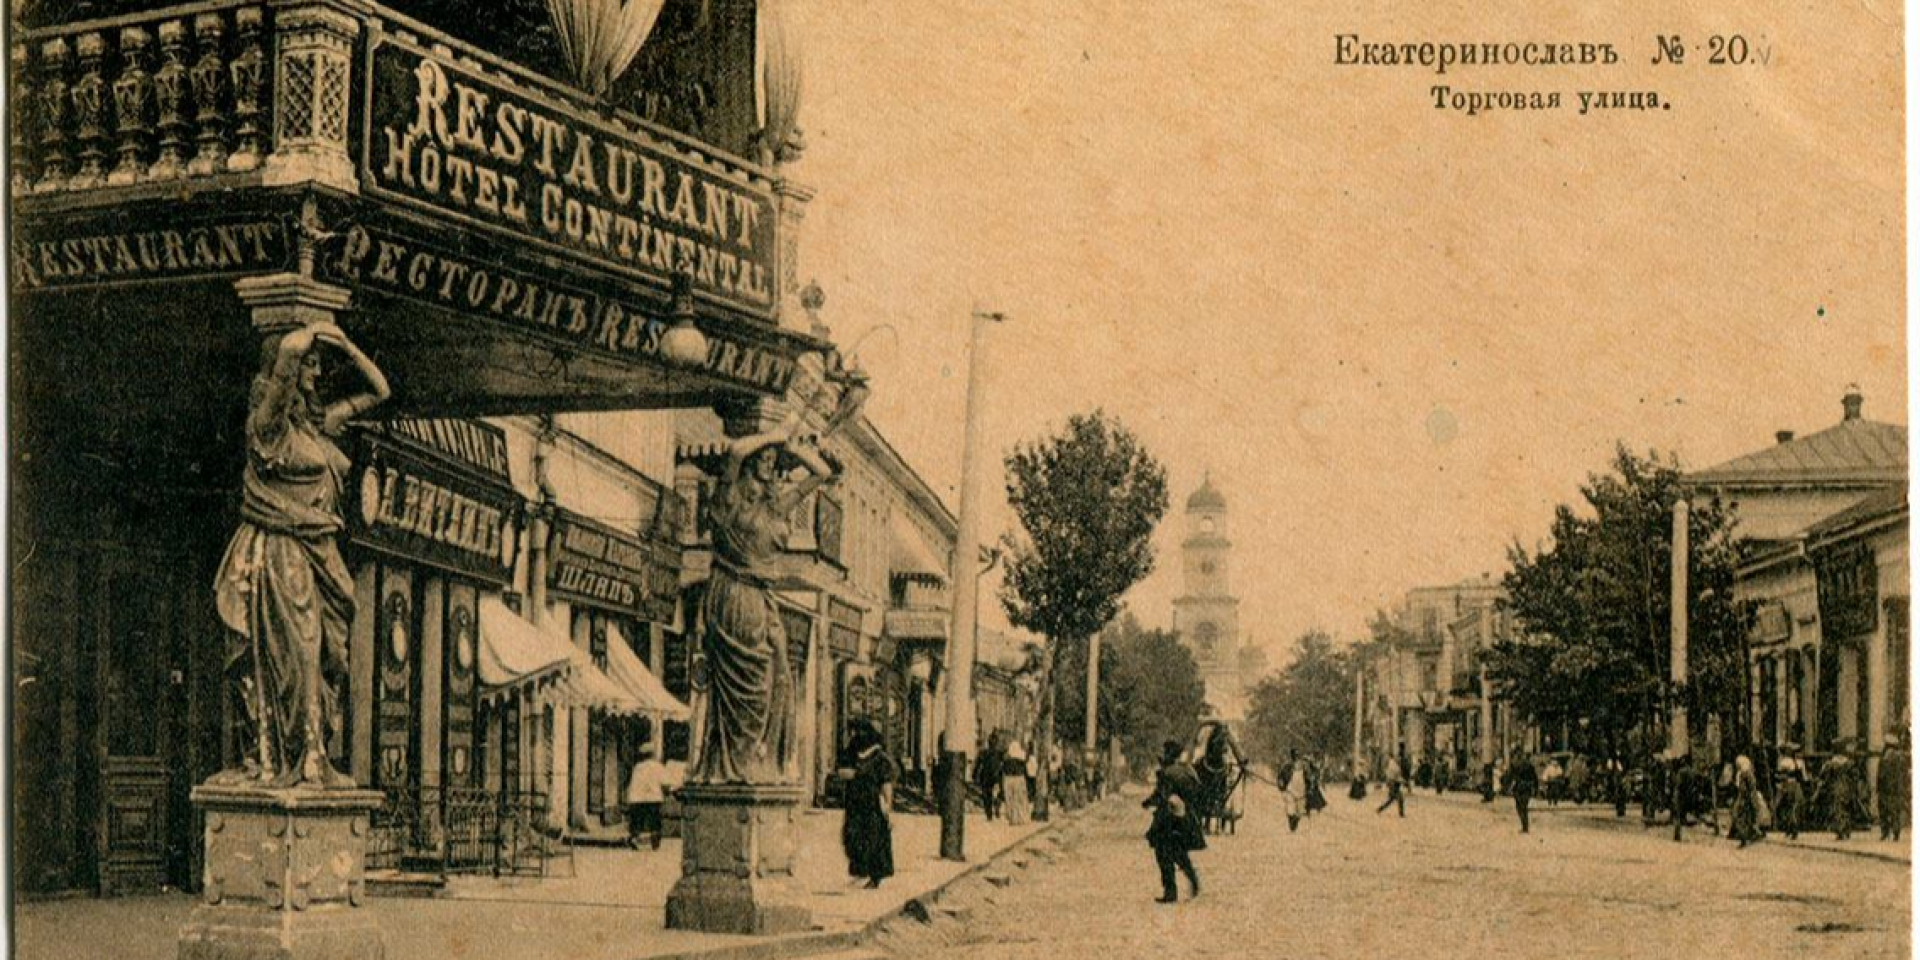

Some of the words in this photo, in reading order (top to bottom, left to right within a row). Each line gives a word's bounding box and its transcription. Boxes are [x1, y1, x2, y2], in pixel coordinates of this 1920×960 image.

[383, 126, 526, 223] HÔTEL
[407, 58, 761, 249] RESTAURANT
[335, 224, 588, 334] РЕСТОРАНЪ
[599, 304, 794, 390] RESURANT
